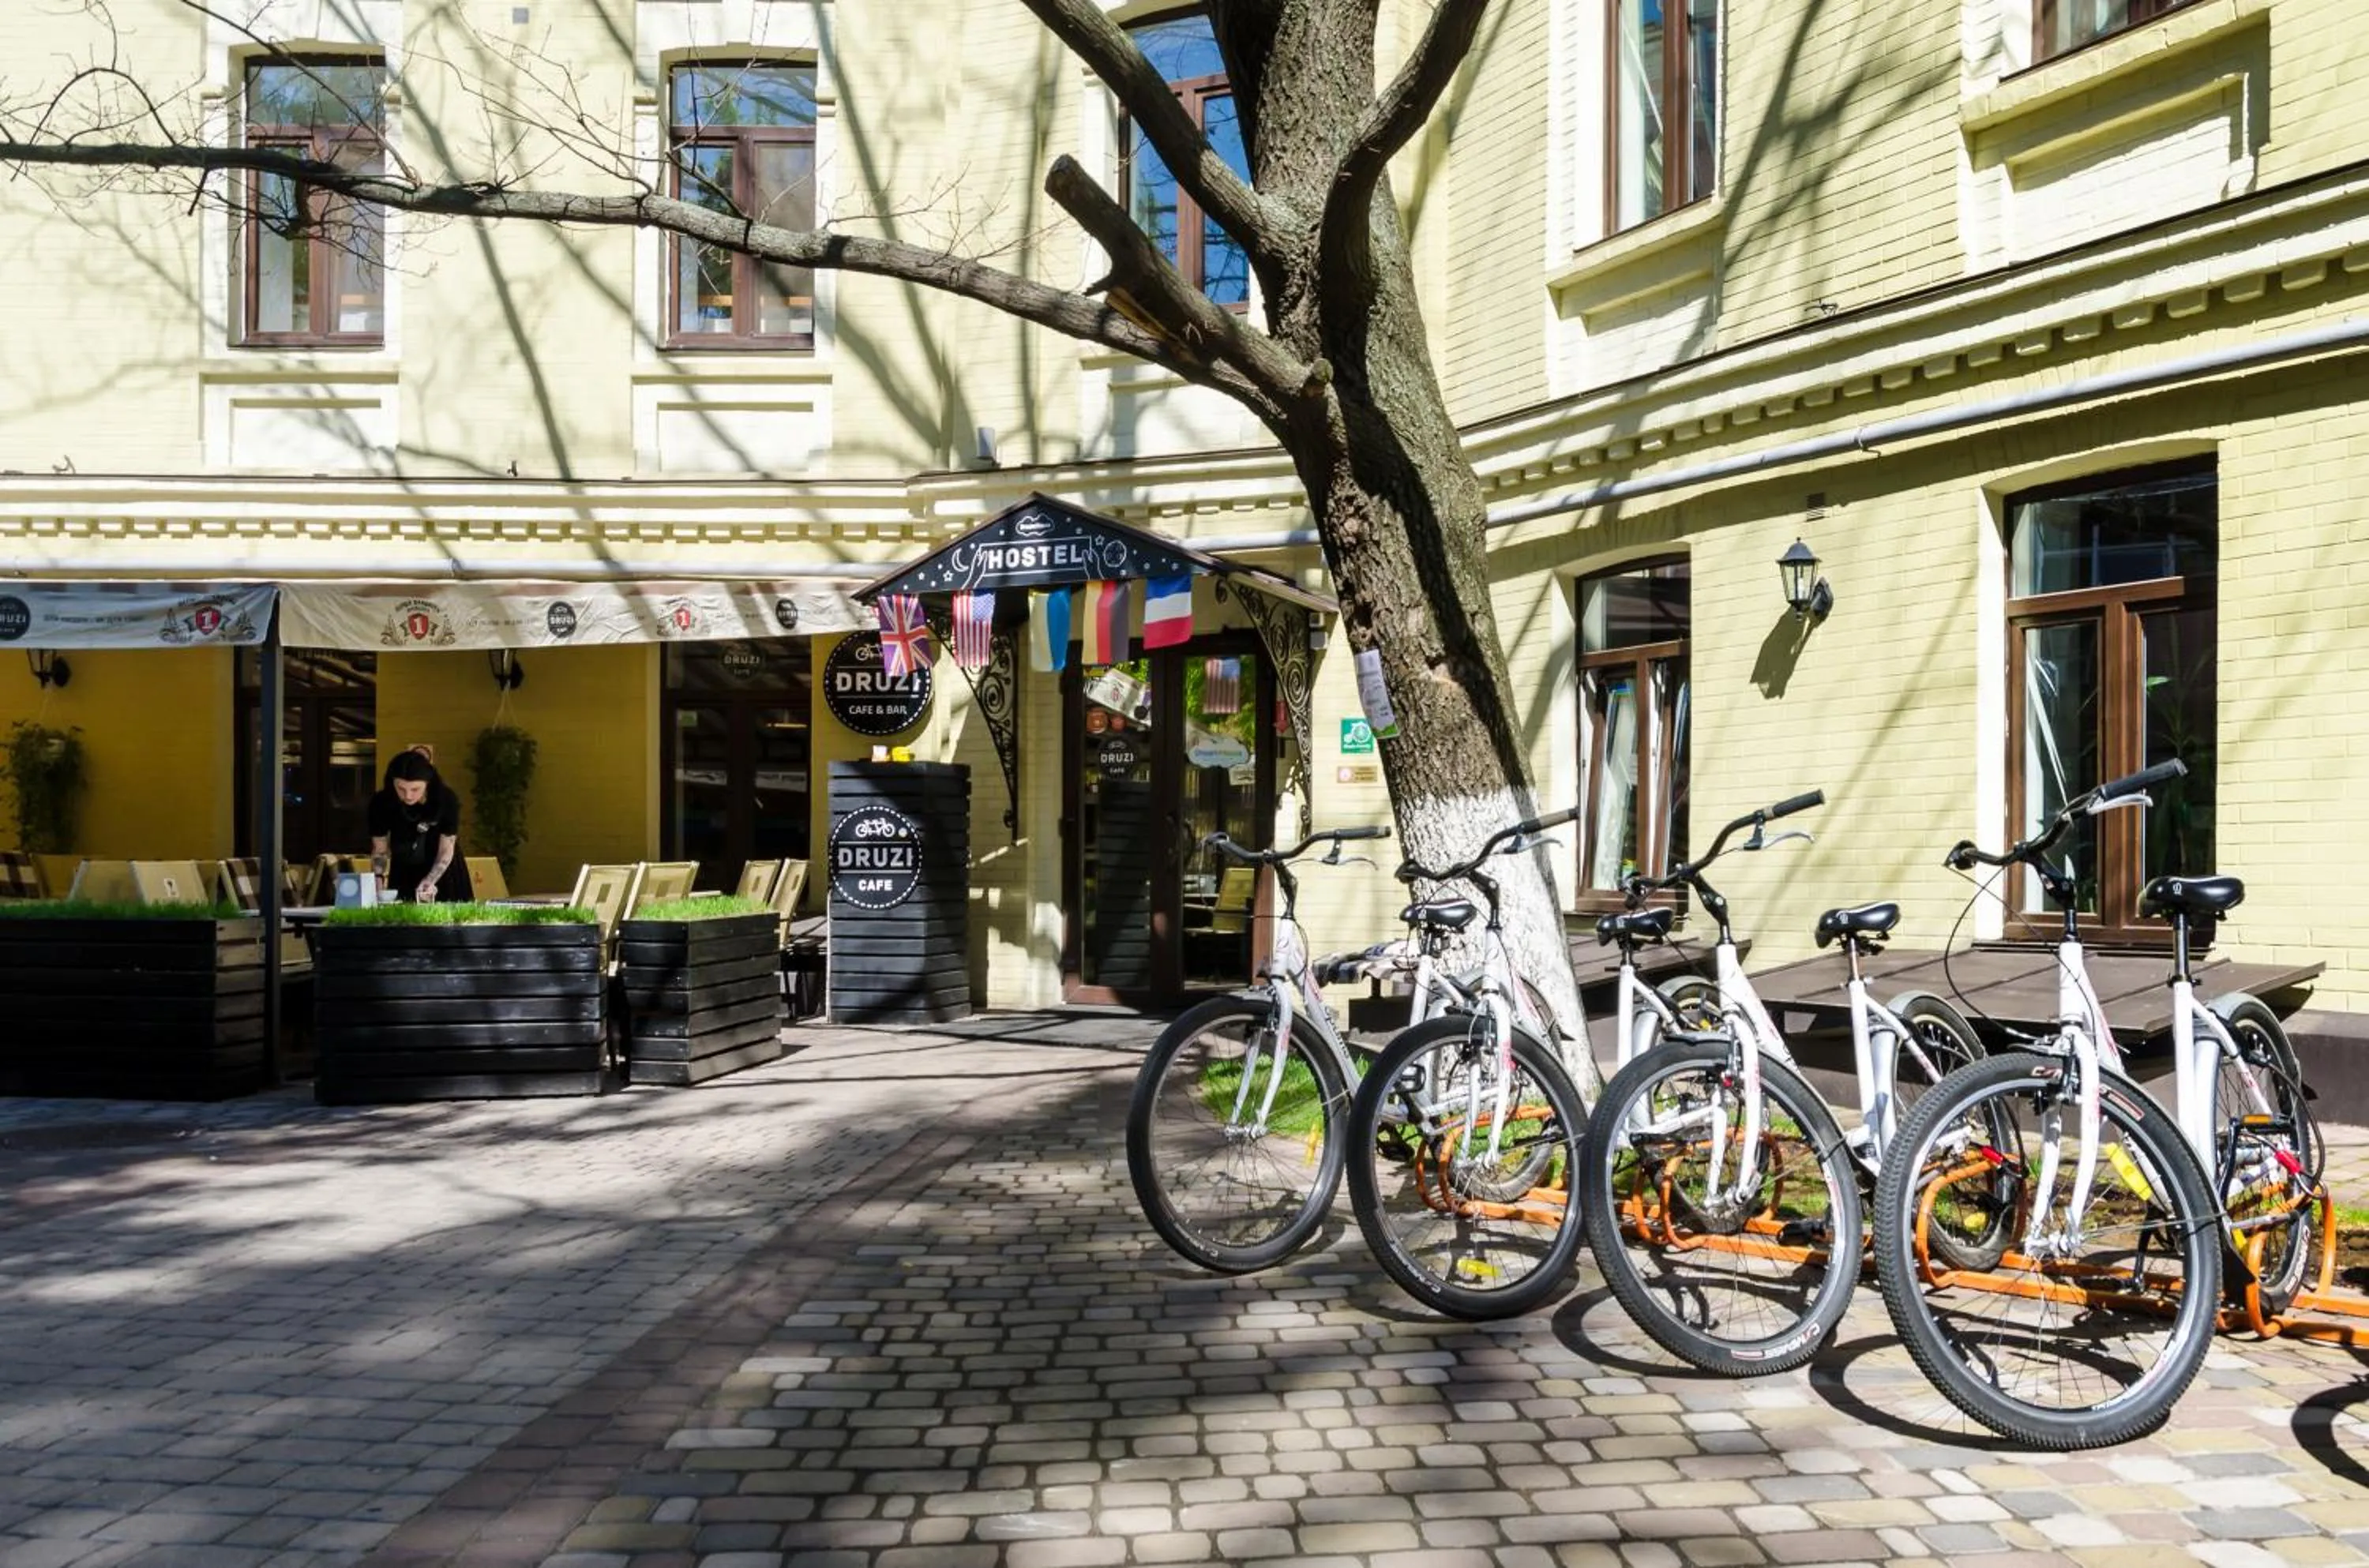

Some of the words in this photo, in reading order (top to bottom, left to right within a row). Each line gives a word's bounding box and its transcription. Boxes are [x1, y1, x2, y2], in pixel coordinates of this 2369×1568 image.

[988, 544, 1083, 569] HOSTEL
[201, 611, 213, 629] 1
[413, 616, 424, 635] 1
[678, 610, 688, 628] 1
[835, 672, 921, 692] DRUZI
[849, 705, 873, 715] CAFE
[876, 705, 884, 715] &
[886, 705, 907, 715] BAR
[1100, 752, 1134, 763] DRUZI
[838, 847, 914, 867] DRUZI
[858, 879, 893, 891] CAFE
